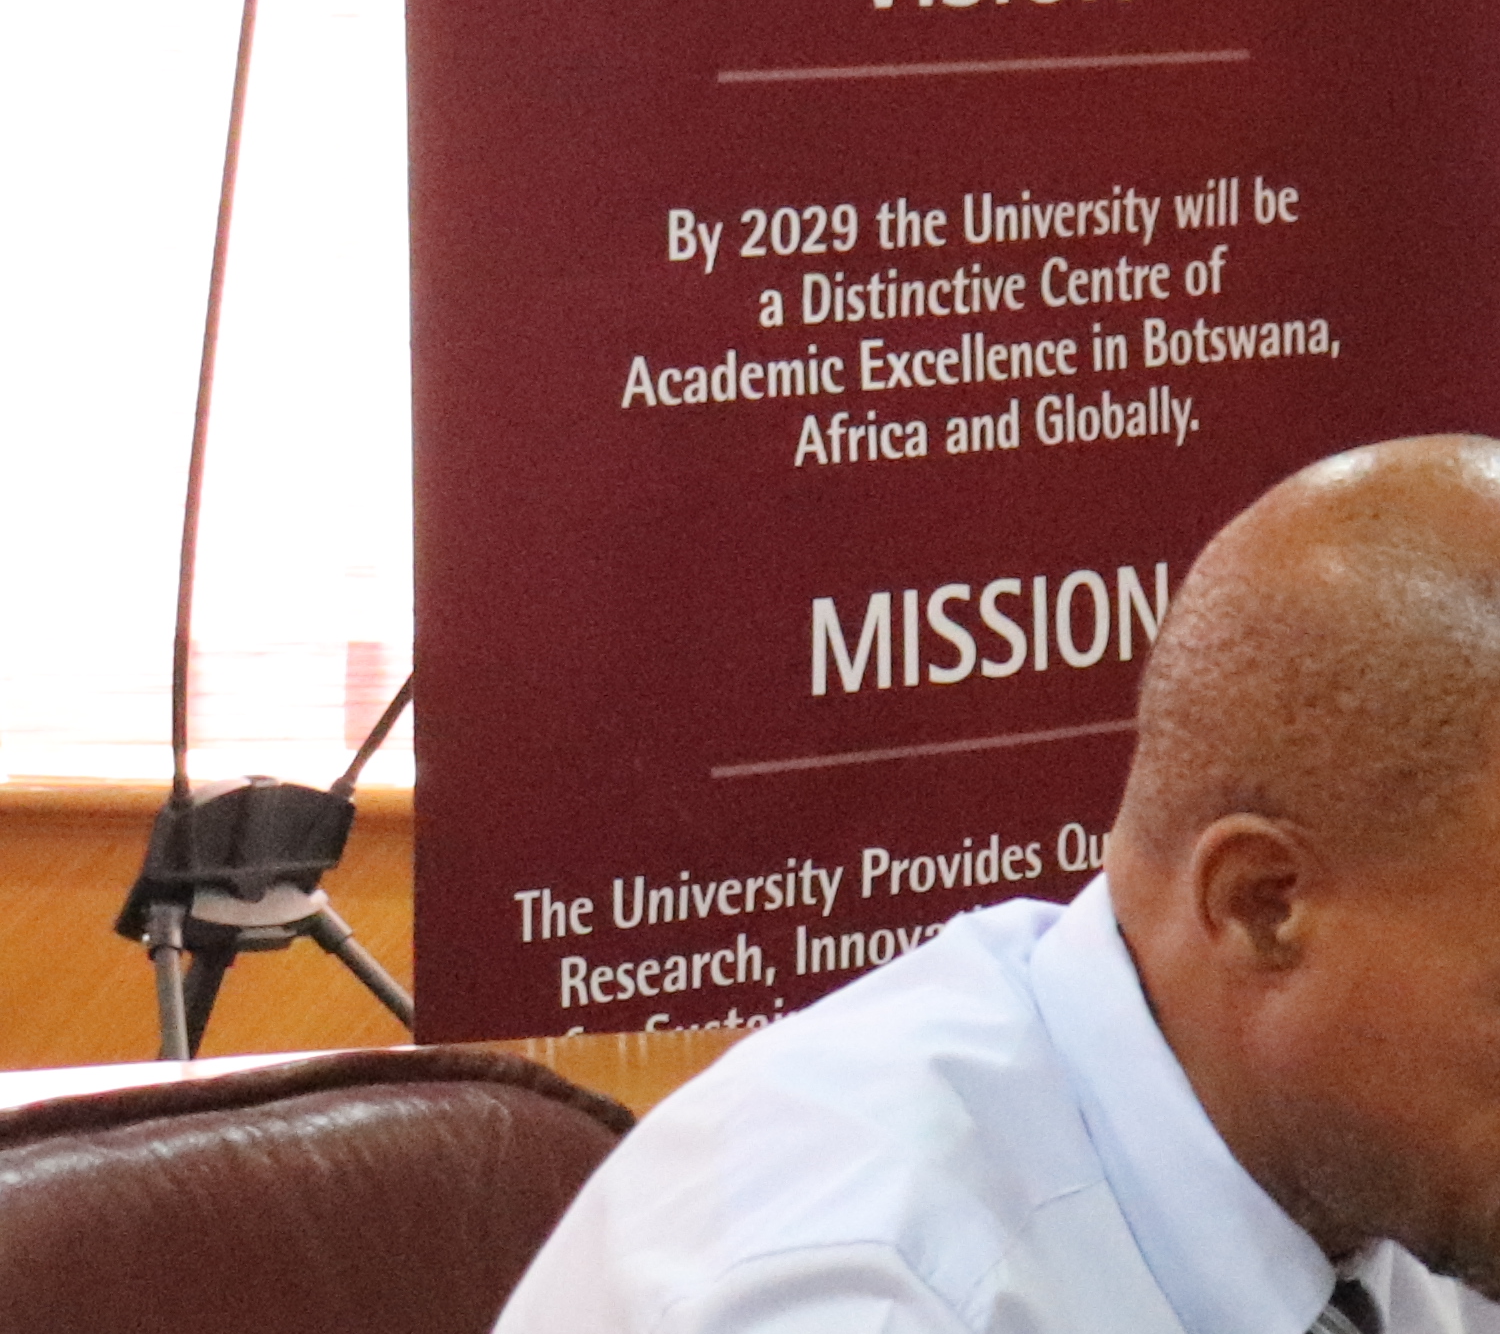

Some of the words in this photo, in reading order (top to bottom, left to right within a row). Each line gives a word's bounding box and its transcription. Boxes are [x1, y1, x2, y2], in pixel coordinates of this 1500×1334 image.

[667, 207, 724, 275] By
[739, 202, 859, 258] 2029
[874, 196, 948, 251] the
[962, 184, 1162, 247] University
[1173, 176, 1240, 230] will
[1253, 175, 1300, 226] be
[758, 288, 785, 329] a
[801, 262, 1027, 325] Distinctive
[1039, 254, 1172, 309] Centre
[1184, 243, 1229, 298] of
[620, 342, 846, 410] Academic
[859, 331, 1078, 392] Excellence
[1091, 321, 1129, 373] in
[1142, 316, 1341, 369] Botswana,
[793, 409, 929, 468] Africa
[945, 397, 1021, 456] and
[1034, 384, 1200, 448] Globally.
[810, 560, 1170, 697] MISSION
[512, 887, 595, 944] The
[611, 857, 845, 930] University
[861, 833, 1043, 899] Provides
[559, 932, 777, 1009] Research,
